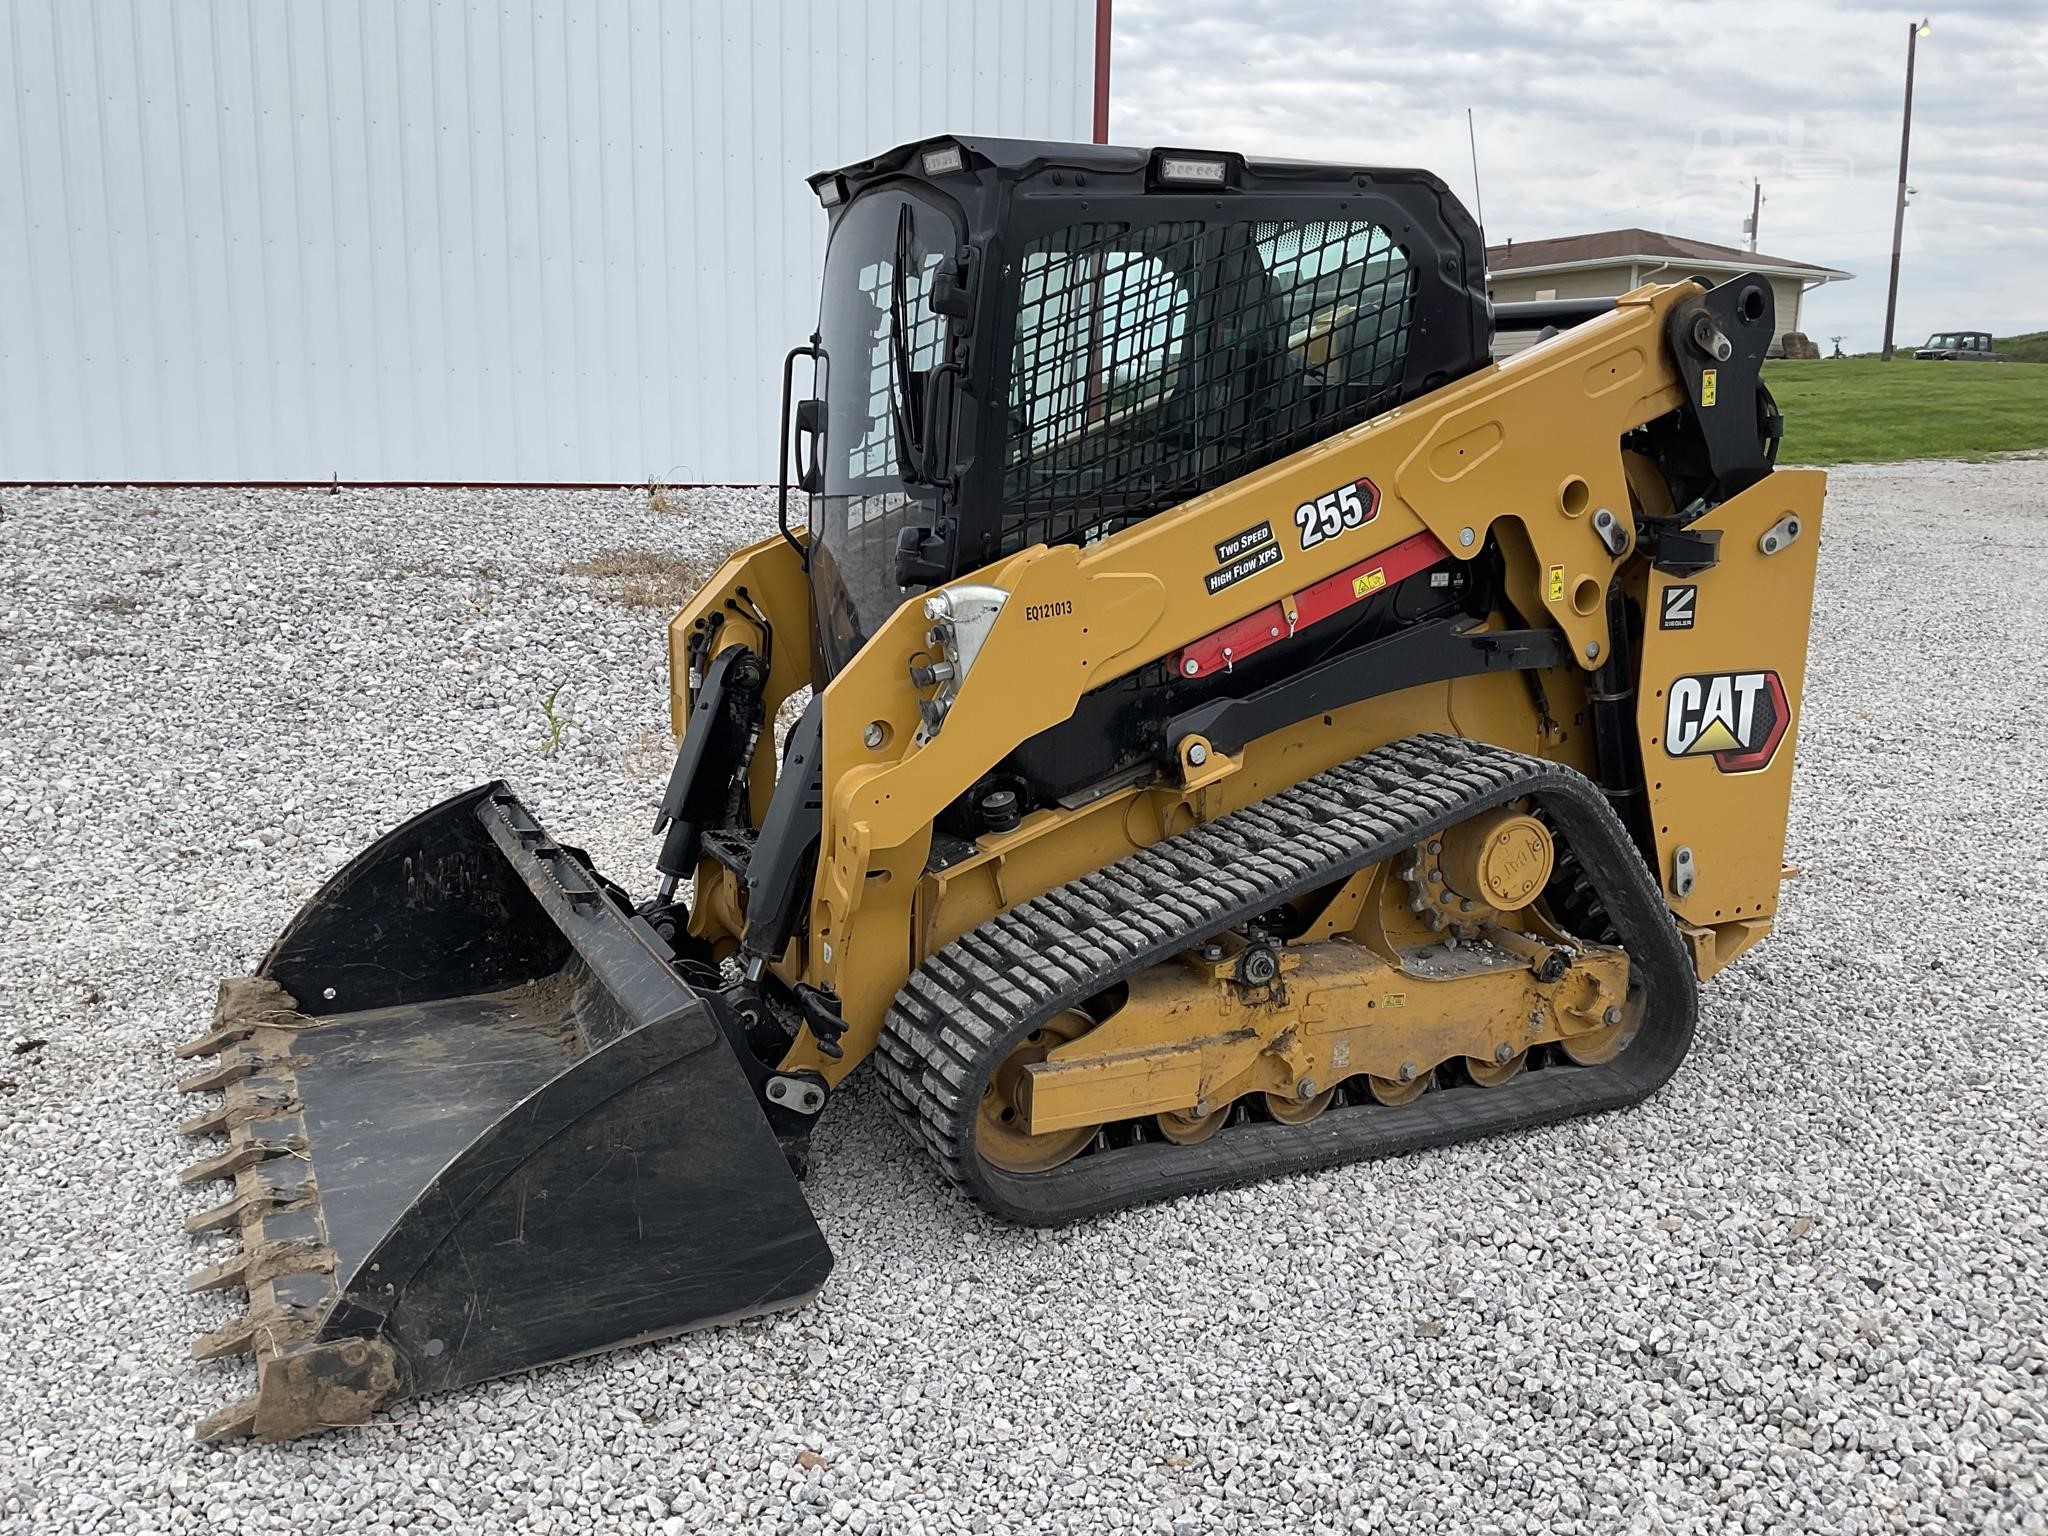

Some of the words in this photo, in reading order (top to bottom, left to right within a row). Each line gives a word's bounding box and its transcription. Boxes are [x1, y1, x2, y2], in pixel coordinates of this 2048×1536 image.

[1296, 483, 1363, 547] 255
[1219, 541, 1239, 558] TWO
[1241, 528, 1268, 548] SPEED
[1210, 571, 1232, 589] HIGH
[1233, 558, 1256, 578] FLOW
[1258, 547, 1277, 565] XPS
[1026, 600, 1072, 621] EQ121013
[1666, 674, 1765, 754] CAT
